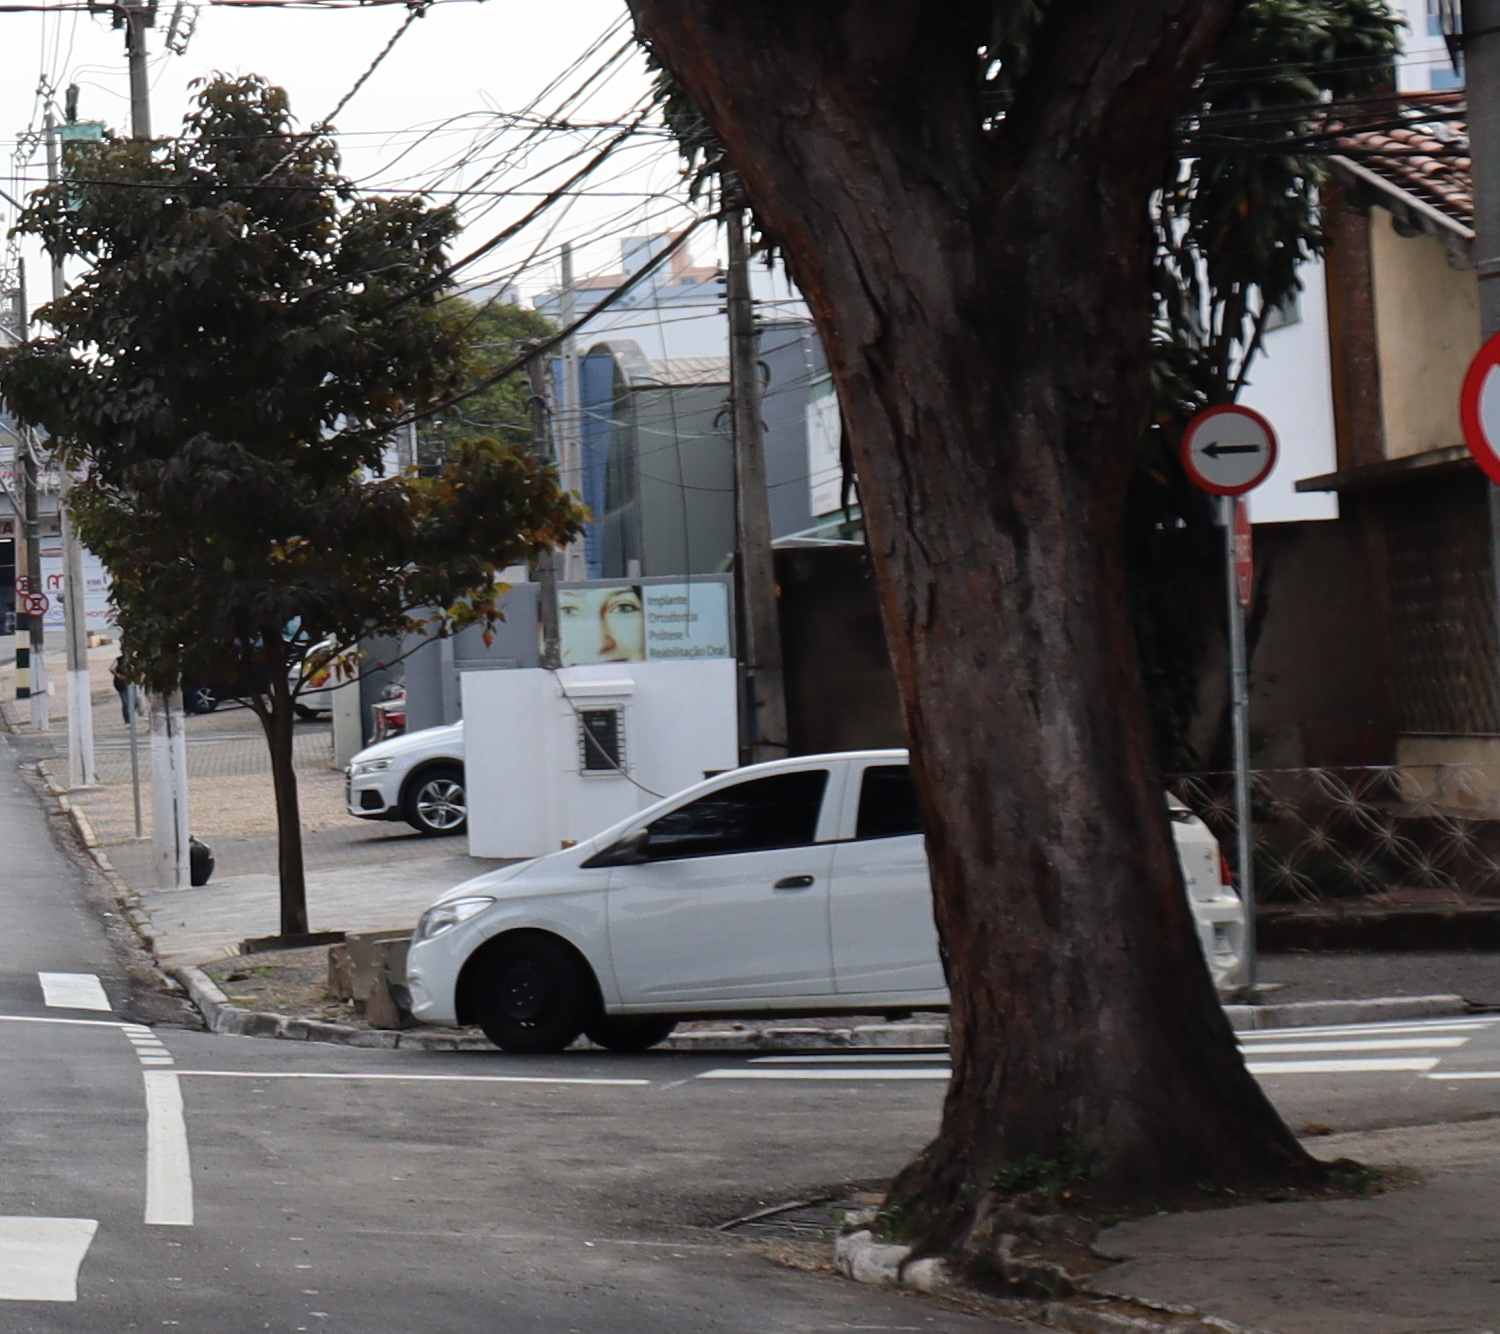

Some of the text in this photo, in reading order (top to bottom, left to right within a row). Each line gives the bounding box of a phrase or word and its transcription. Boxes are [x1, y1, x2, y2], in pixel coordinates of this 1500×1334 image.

[648, 595, 689, 608] Implante
[649, 629, 684, 641] Prótese
[707, 645, 727, 656] Oral
